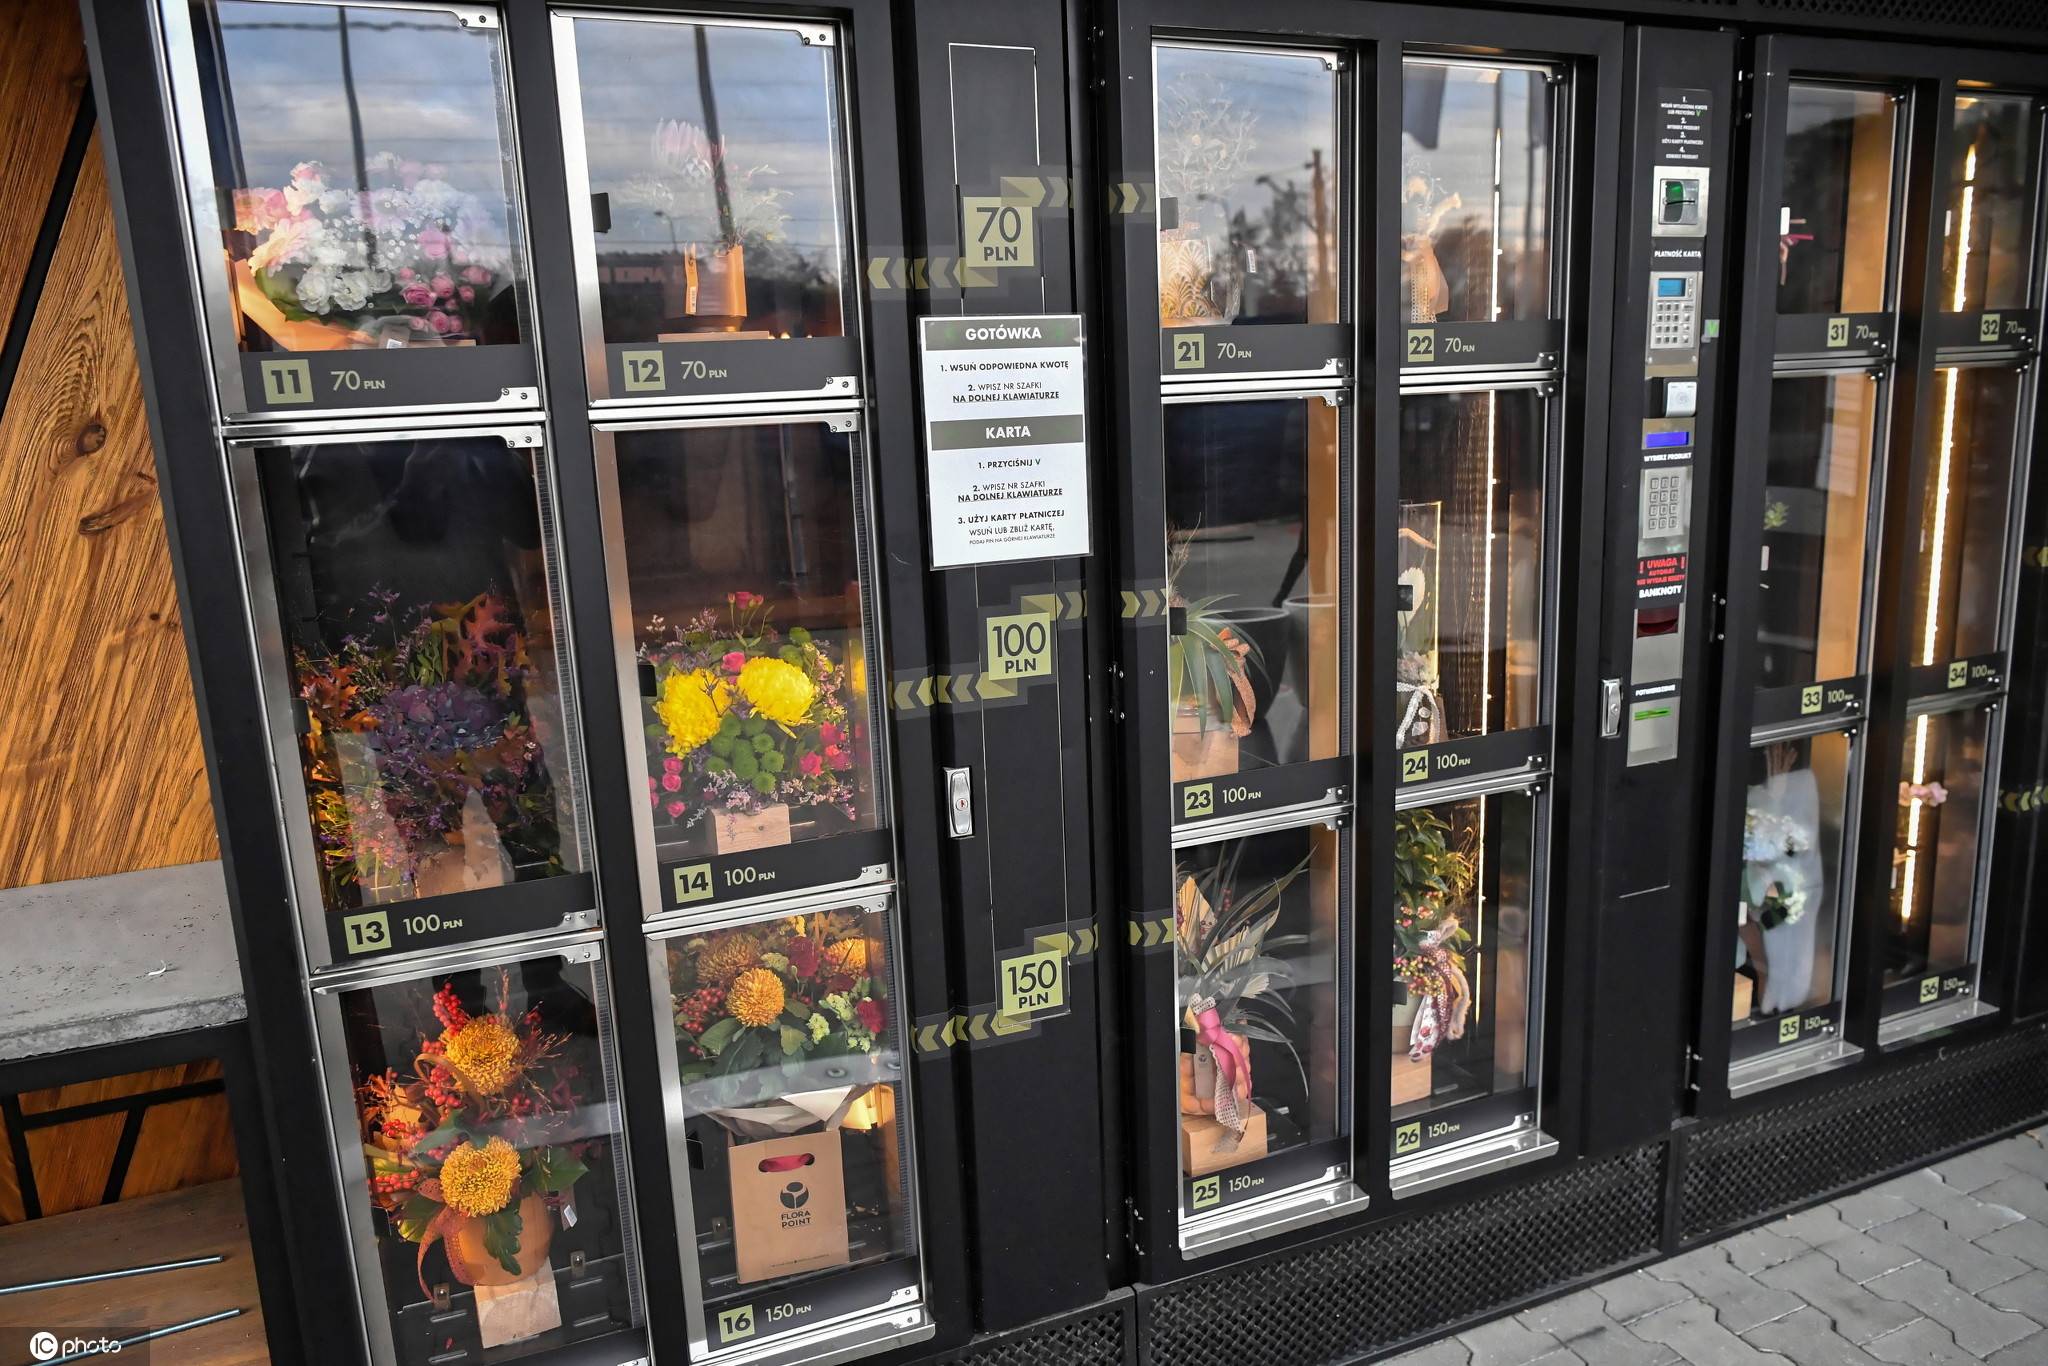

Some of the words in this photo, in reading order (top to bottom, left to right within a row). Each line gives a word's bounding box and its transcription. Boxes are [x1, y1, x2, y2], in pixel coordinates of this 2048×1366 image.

[977, 207, 1021, 243] 70
[984, 247, 1018, 261] PLN
[966, 324, 1042, 341] GOTÓWKA
[1830, 325, 1845, 341] 31
[1856, 325, 1869, 339] 70
[1982, 320, 1998, 335] 32
[1177, 341, 1200, 362] 21
[1217, 342, 1236, 359] 70
[1409, 335, 1433, 355] 22
[1444, 338, 1461, 353] 70
[628, 359, 660, 383] 12
[681, 361, 706, 380] 70
[709, 370, 728, 379] PLN
[941, 364, 948, 372] 1.
[950, 362, 977, 372] WSUŃ
[979, 362, 1038, 371] ODPOWIEDNA
[1040, 361, 1069, 370] KWOTĘ
[271, 370, 302, 395] 11
[331, 371, 360, 391] 70
[364, 380, 386, 390] PLN
[968, 384, 976, 392] 2.
[978, 383, 1002, 391] WPISZ
[1003, 382, 1014, 390] NR
[1016, 381, 1042, 390] SZAFKI
[953, 395, 966, 403] NA
[968, 394, 1000, 402] DOLNEJ
[1003, 391, 1060, 401] KLAWIATURZE
[986, 426, 1031, 439] KARTA
[987, 458, 1033, 469] PRZYCIŚNIJ
[982, 483, 1005, 491] WPISZ
[1020, 480, 1046, 489] SZAFKI
[958, 495, 971, 503] NA
[973, 493, 1004, 501] DOLNEJ
[1006, 488, 1063, 499] KLAWIATURZE
[968, 514, 989, 524] UŻYJ
[990, 513, 1017, 522] KARTY
[1019, 509, 1065, 520] PŁATNICZEJ
[969, 526, 993, 536] WSUŃ
[994, 527, 1008, 535] LUB
[1647, 557, 1678, 569] UWAGA
[1639, 585, 1683, 599] BANKNOTY
[992, 622, 1046, 657] 100
[1005, 658, 1036, 674] PLN
[1804, 691, 1820, 708] 33
[1827, 689, 1845, 704] 100
[1405, 756, 1427, 776] 24
[1436, 753, 1458, 770] 100
[1458, 758, 1471, 766] PLN
[1186, 790, 1211, 811] 23
[1222, 787, 1247, 804] 100
[1248, 792, 1262, 800] PLN
[679, 871, 709, 894] 14
[725, 867, 757, 887] 100
[758, 872, 776, 881] PLN
[351, 921, 386, 945] 13
[403, 914, 440, 936] 100
[443, 919, 464, 930] PLN
[1008, 960, 1056, 995] 150
[1922, 982, 1938, 997] 36
[1018, 992, 1048, 1009] PLN
[1782, 1021, 1797, 1037] 35
[1804, 1015, 1821, 1030] 150
[1398, 1129, 1418, 1148] 26
[1428, 1122, 1448, 1138] 150
[1195, 1182, 1218, 1203] 25
[1228, 1175, 1251, 1192] 150
[1252, 1177, 1265, 1186] PLN
[781, 1211, 810, 1221] FLORA
[781, 1217, 811, 1228] POINT
[724, 1313, 751, 1335] 16
[766, 1303, 793, 1323] 150
[796, 1305, 813, 1316] PLN
